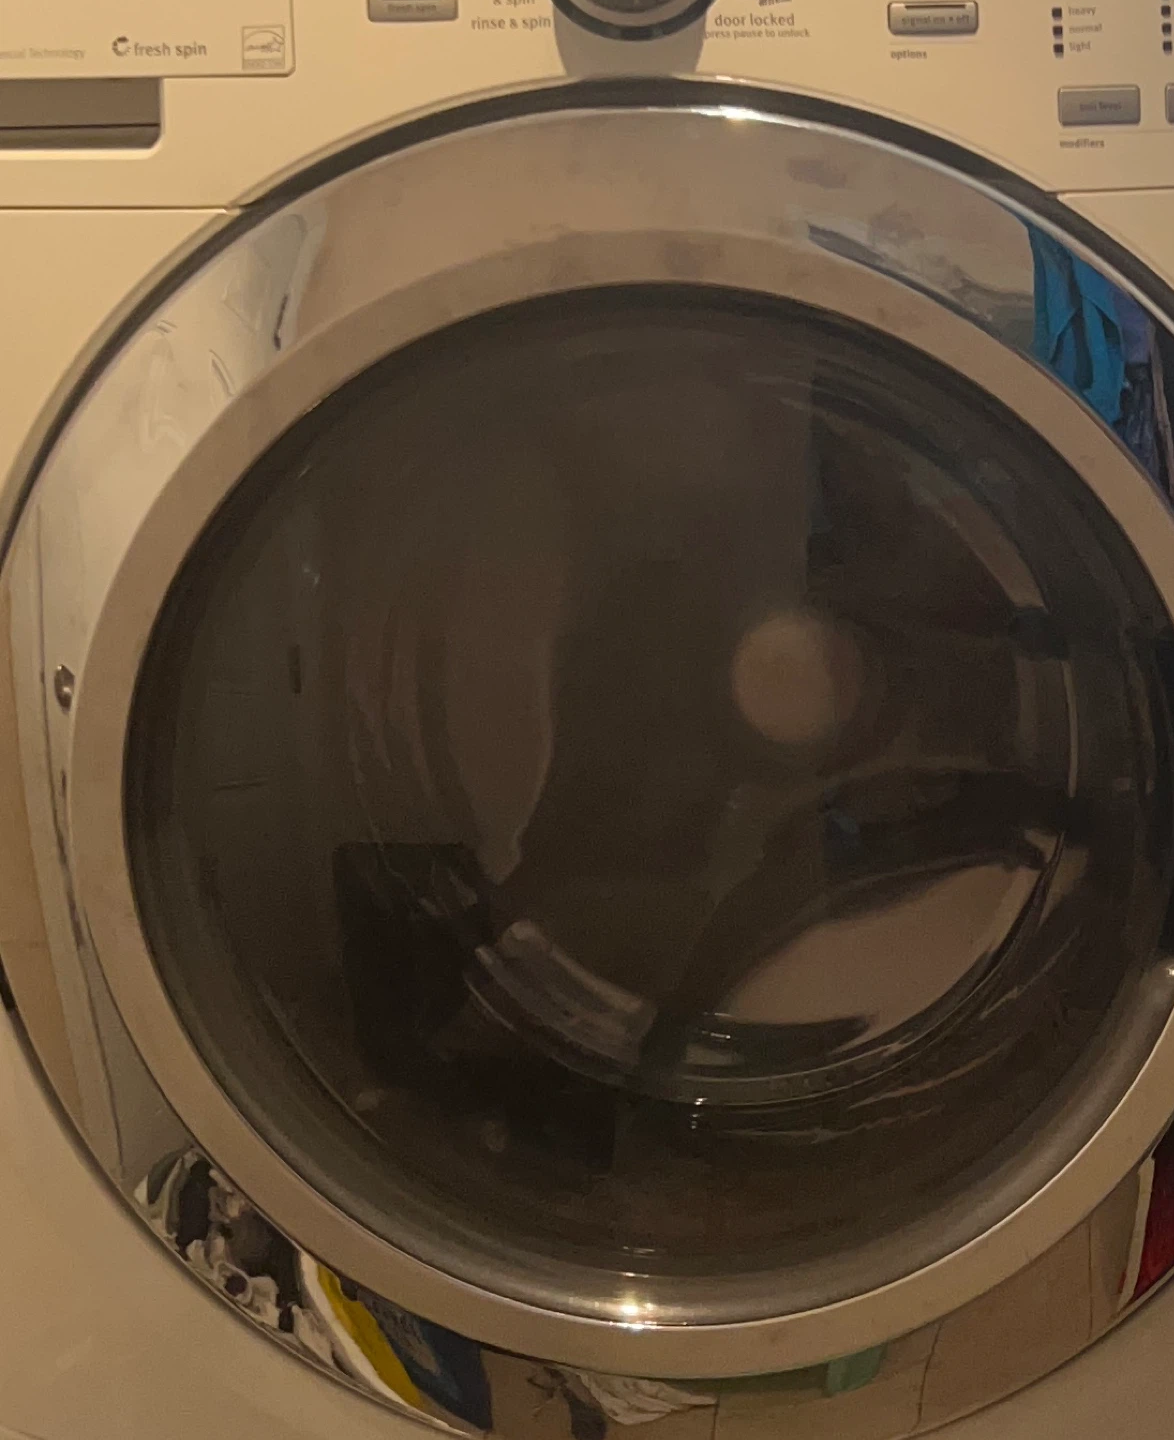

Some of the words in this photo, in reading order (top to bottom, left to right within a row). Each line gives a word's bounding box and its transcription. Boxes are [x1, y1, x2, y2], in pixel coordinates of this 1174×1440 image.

[471, 16, 506, 30] rinse
[522, 16, 551, 32] spin
[714, 14, 746, 27] door
[750, 13, 795, 27] locked
[133, 42, 171, 57] fresh
[175, 41, 207, 60] spin
[890, 49, 928, 61] options
